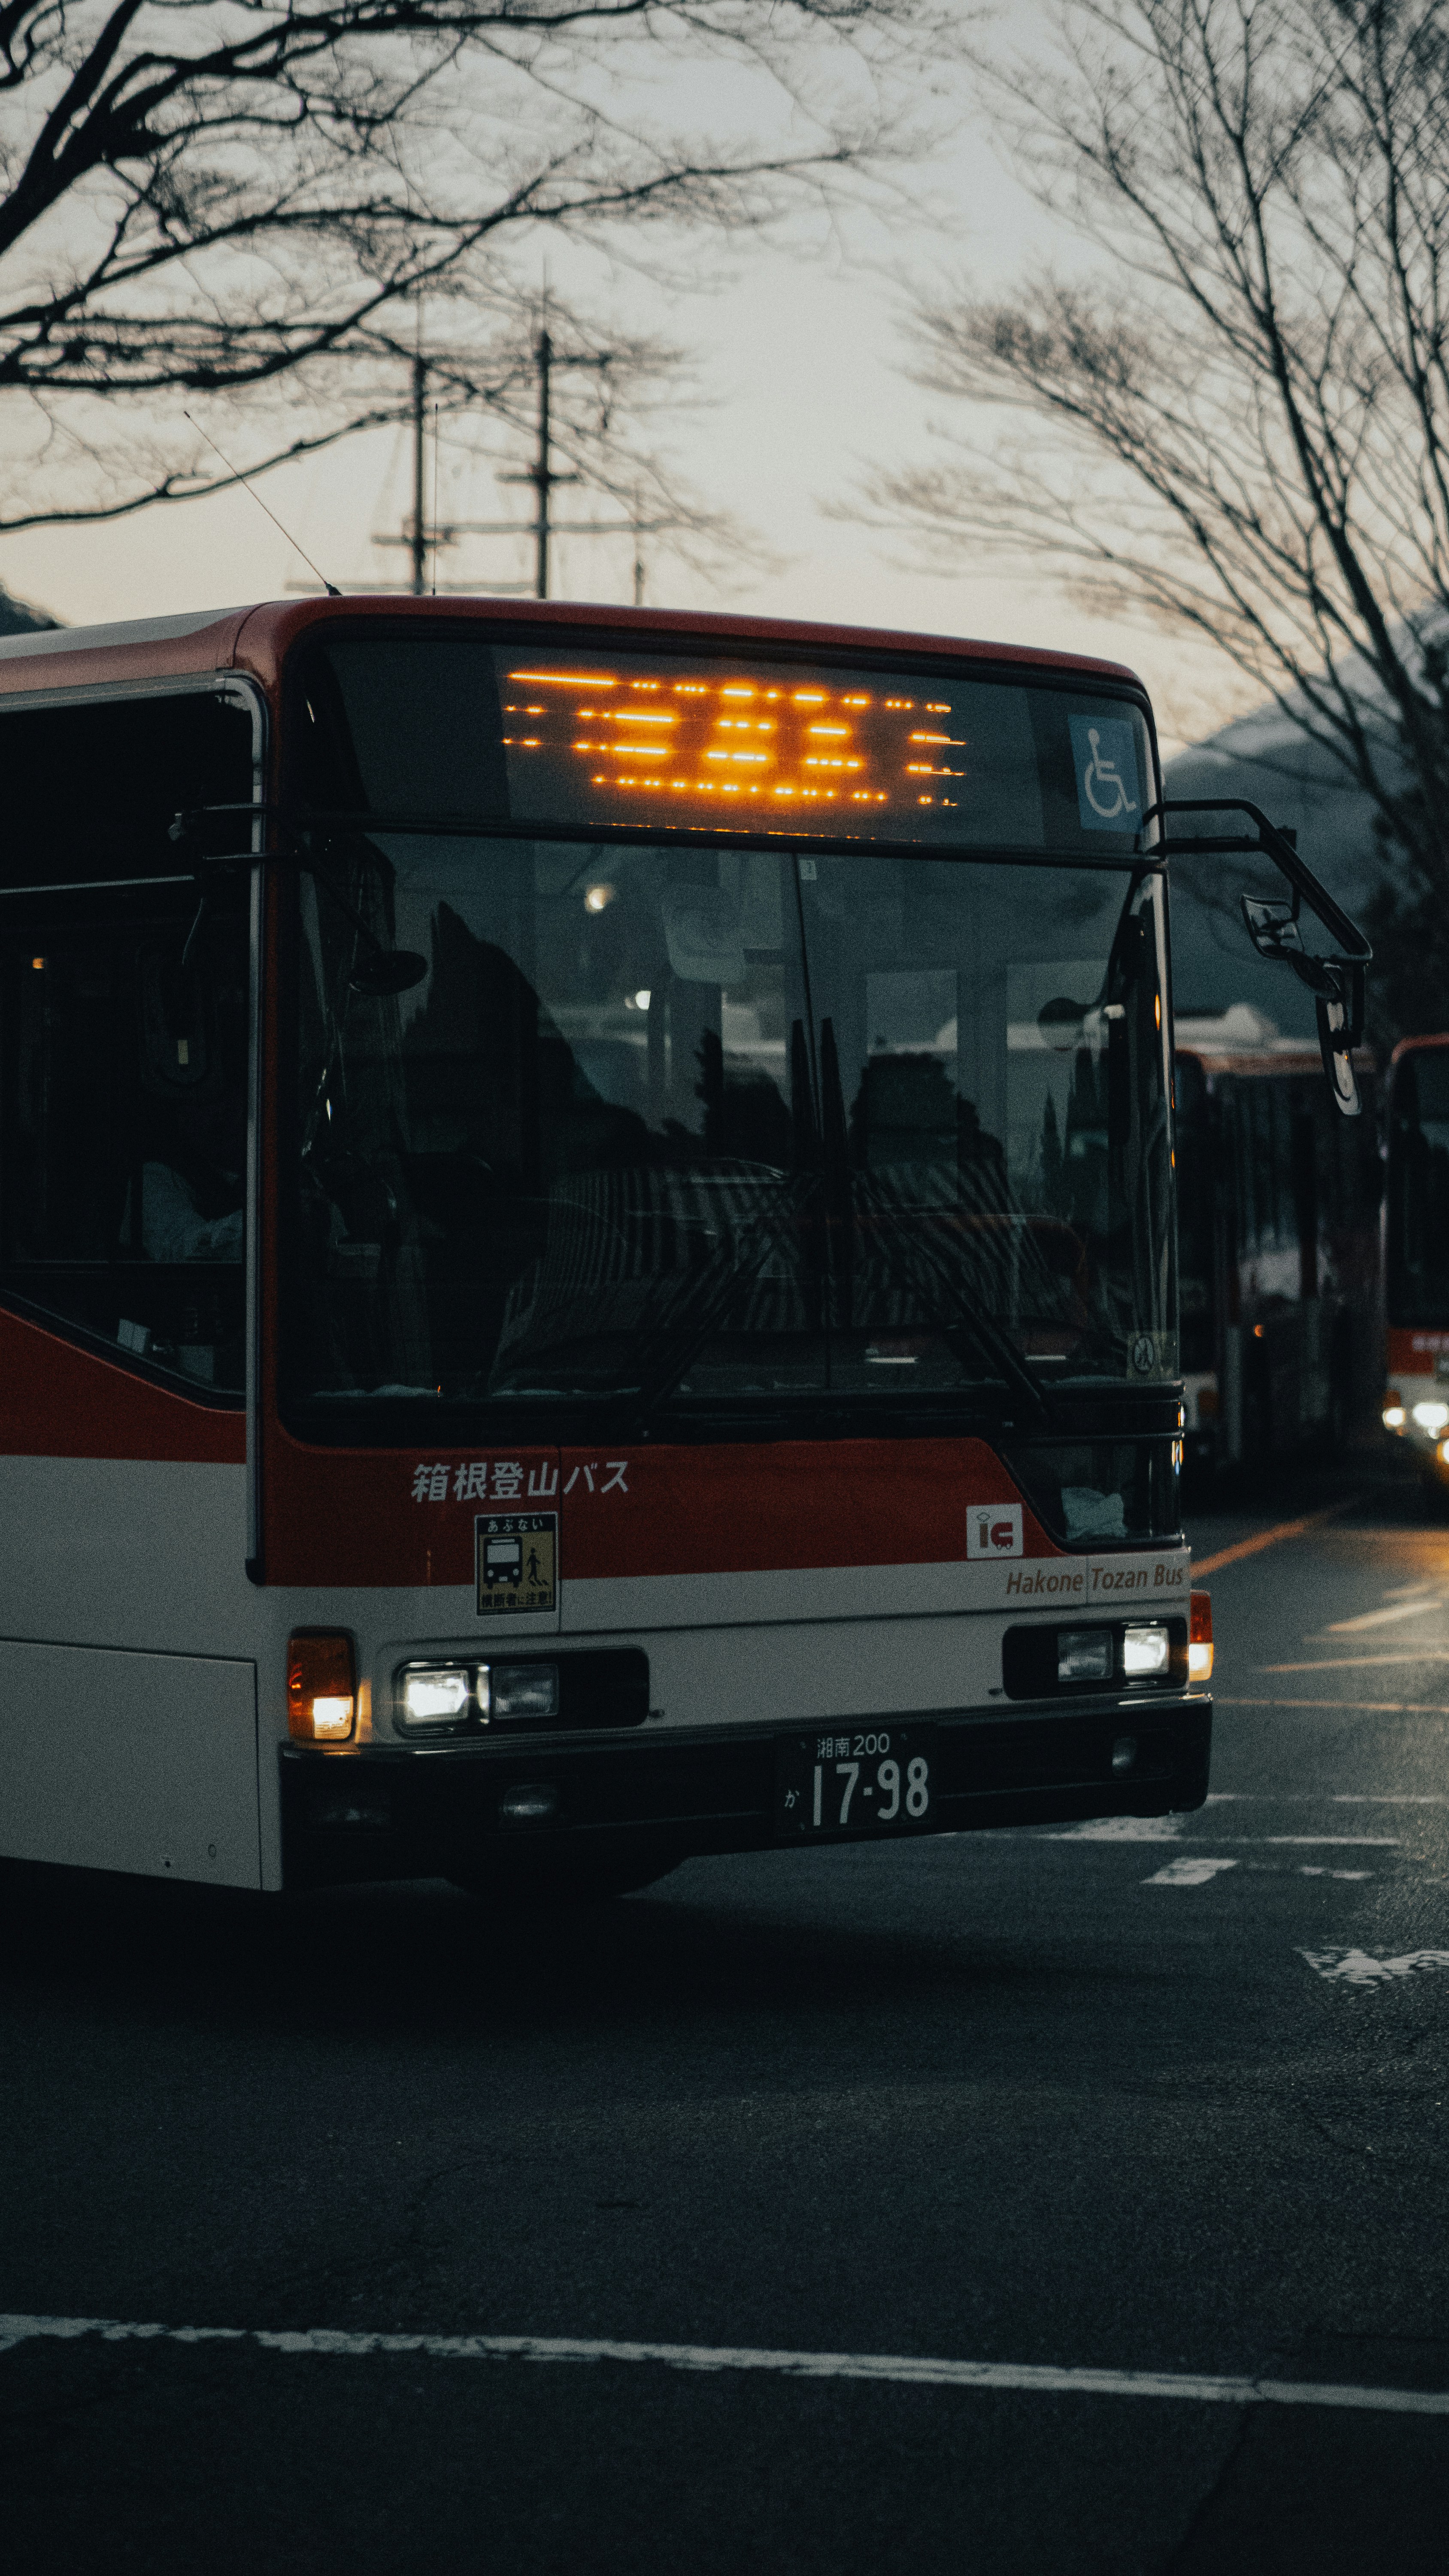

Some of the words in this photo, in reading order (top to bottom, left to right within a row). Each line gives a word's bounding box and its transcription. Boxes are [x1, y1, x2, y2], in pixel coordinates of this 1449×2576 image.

[411, 1461, 629, 1503] 箱根登山バス
[487, 1518, 543, 1532] あぶない
[1006, 1570, 1084, 1594] Hakone
[1091, 1567, 1148, 1589] Tozan
[1154, 1564, 1183, 1586] Bus
[813, 1757, 929, 1826] 17-98
